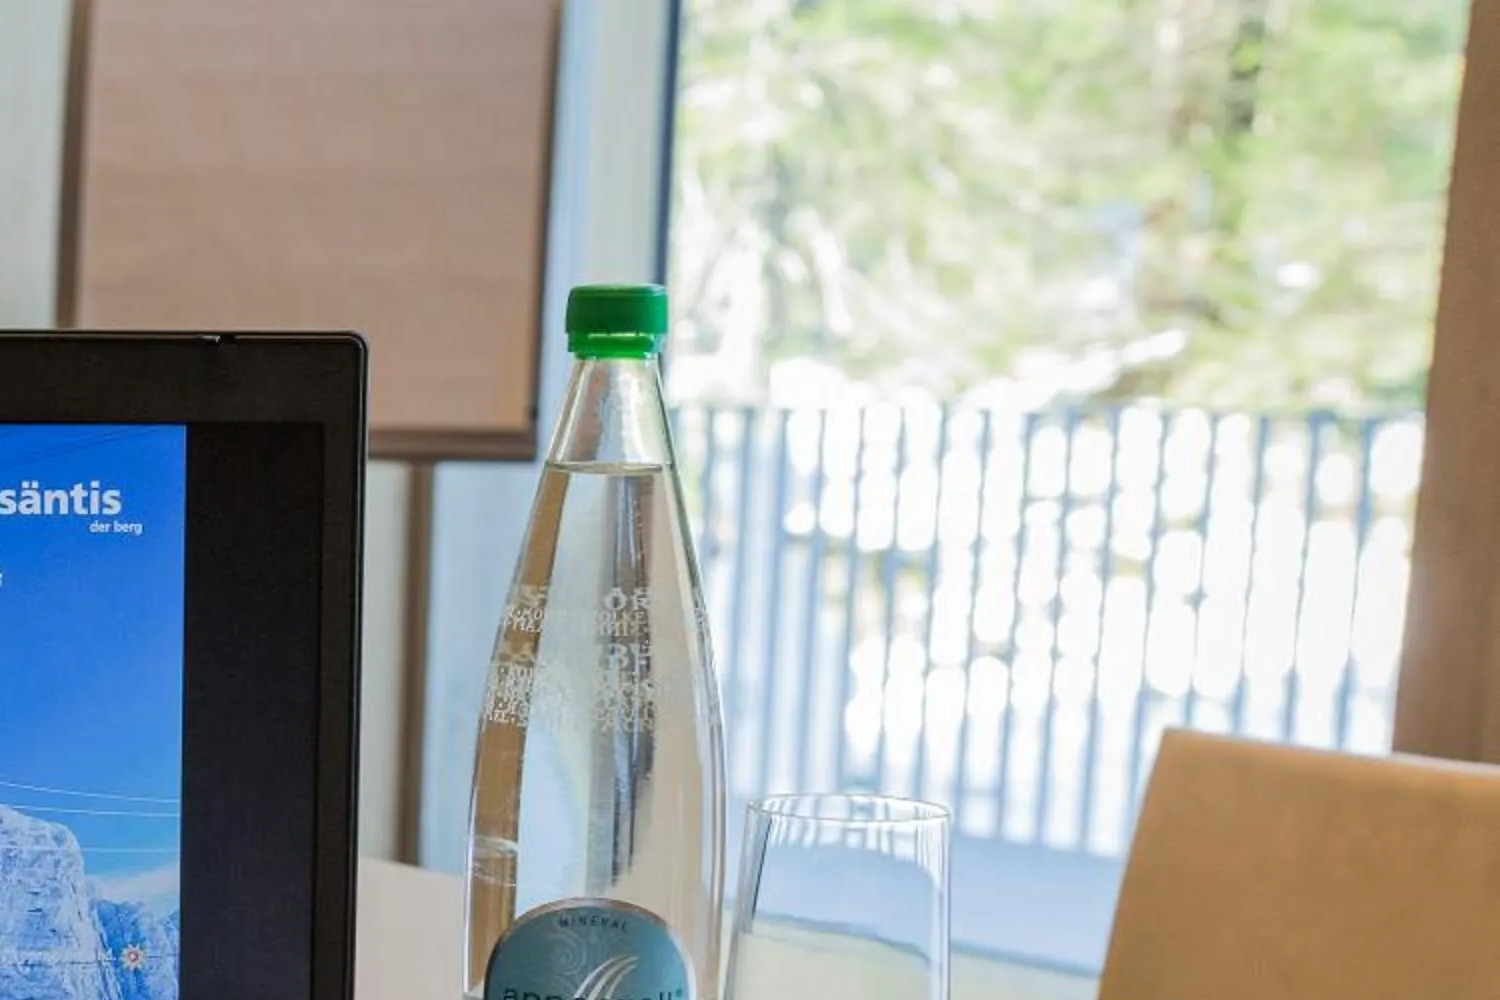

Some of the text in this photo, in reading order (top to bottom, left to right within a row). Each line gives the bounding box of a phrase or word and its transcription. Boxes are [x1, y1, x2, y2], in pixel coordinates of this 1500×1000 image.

[89, 520, 143, 535] der berg
[558, 914, 629, 933] MINERAL
